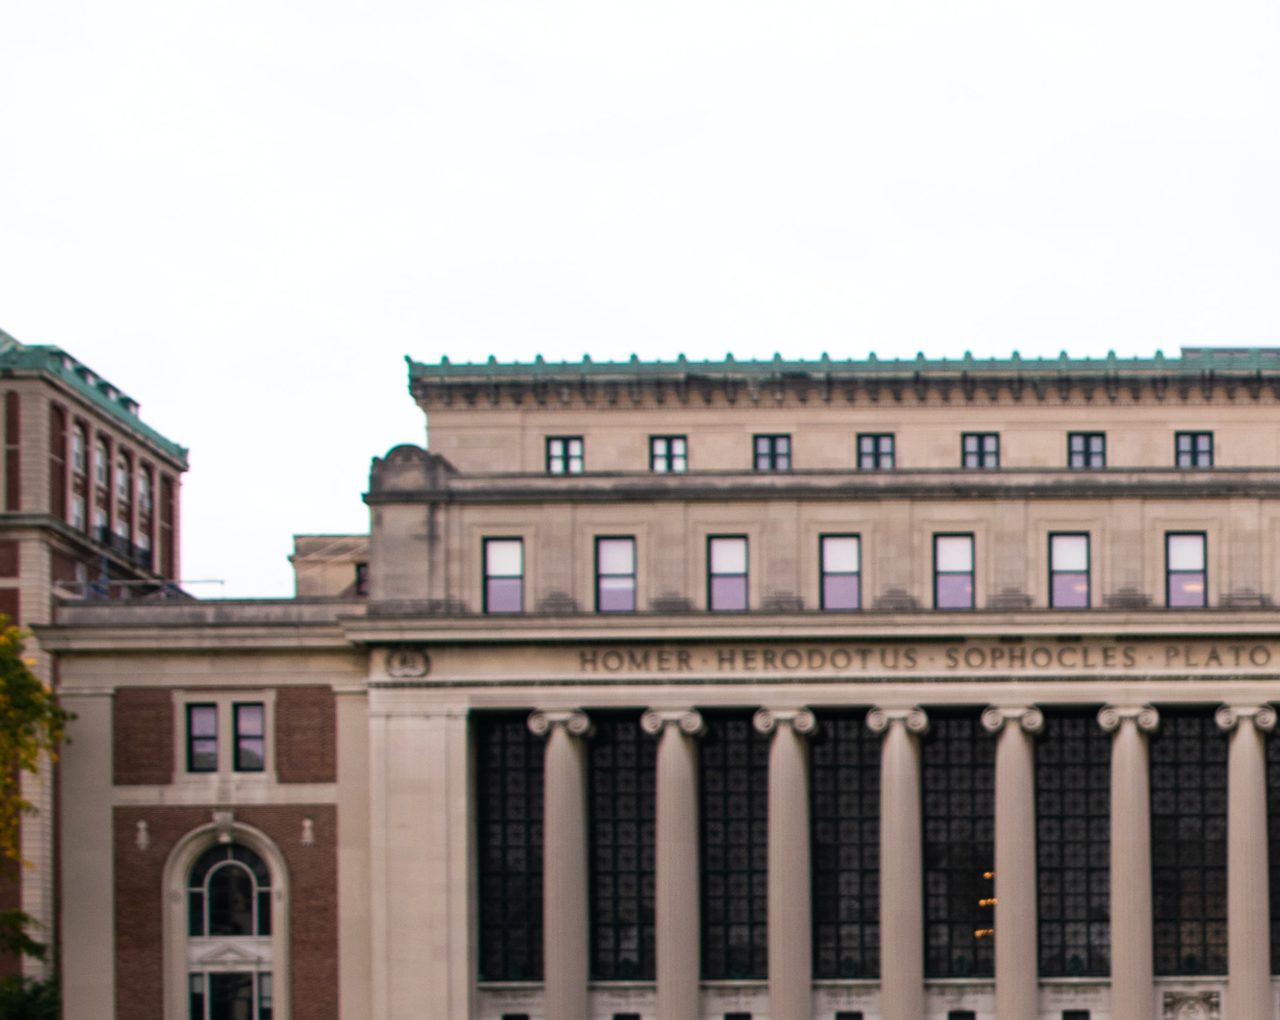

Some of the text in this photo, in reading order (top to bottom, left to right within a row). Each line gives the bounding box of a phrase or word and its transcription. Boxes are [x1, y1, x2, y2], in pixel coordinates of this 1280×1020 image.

[578, 648, 694, 672] HOMER
[717, 647, 917, 671] HERODOTUS
[948, 645, 1137, 670] SOPHOCLES
[1164, 645, 1271, 668] PLATO
